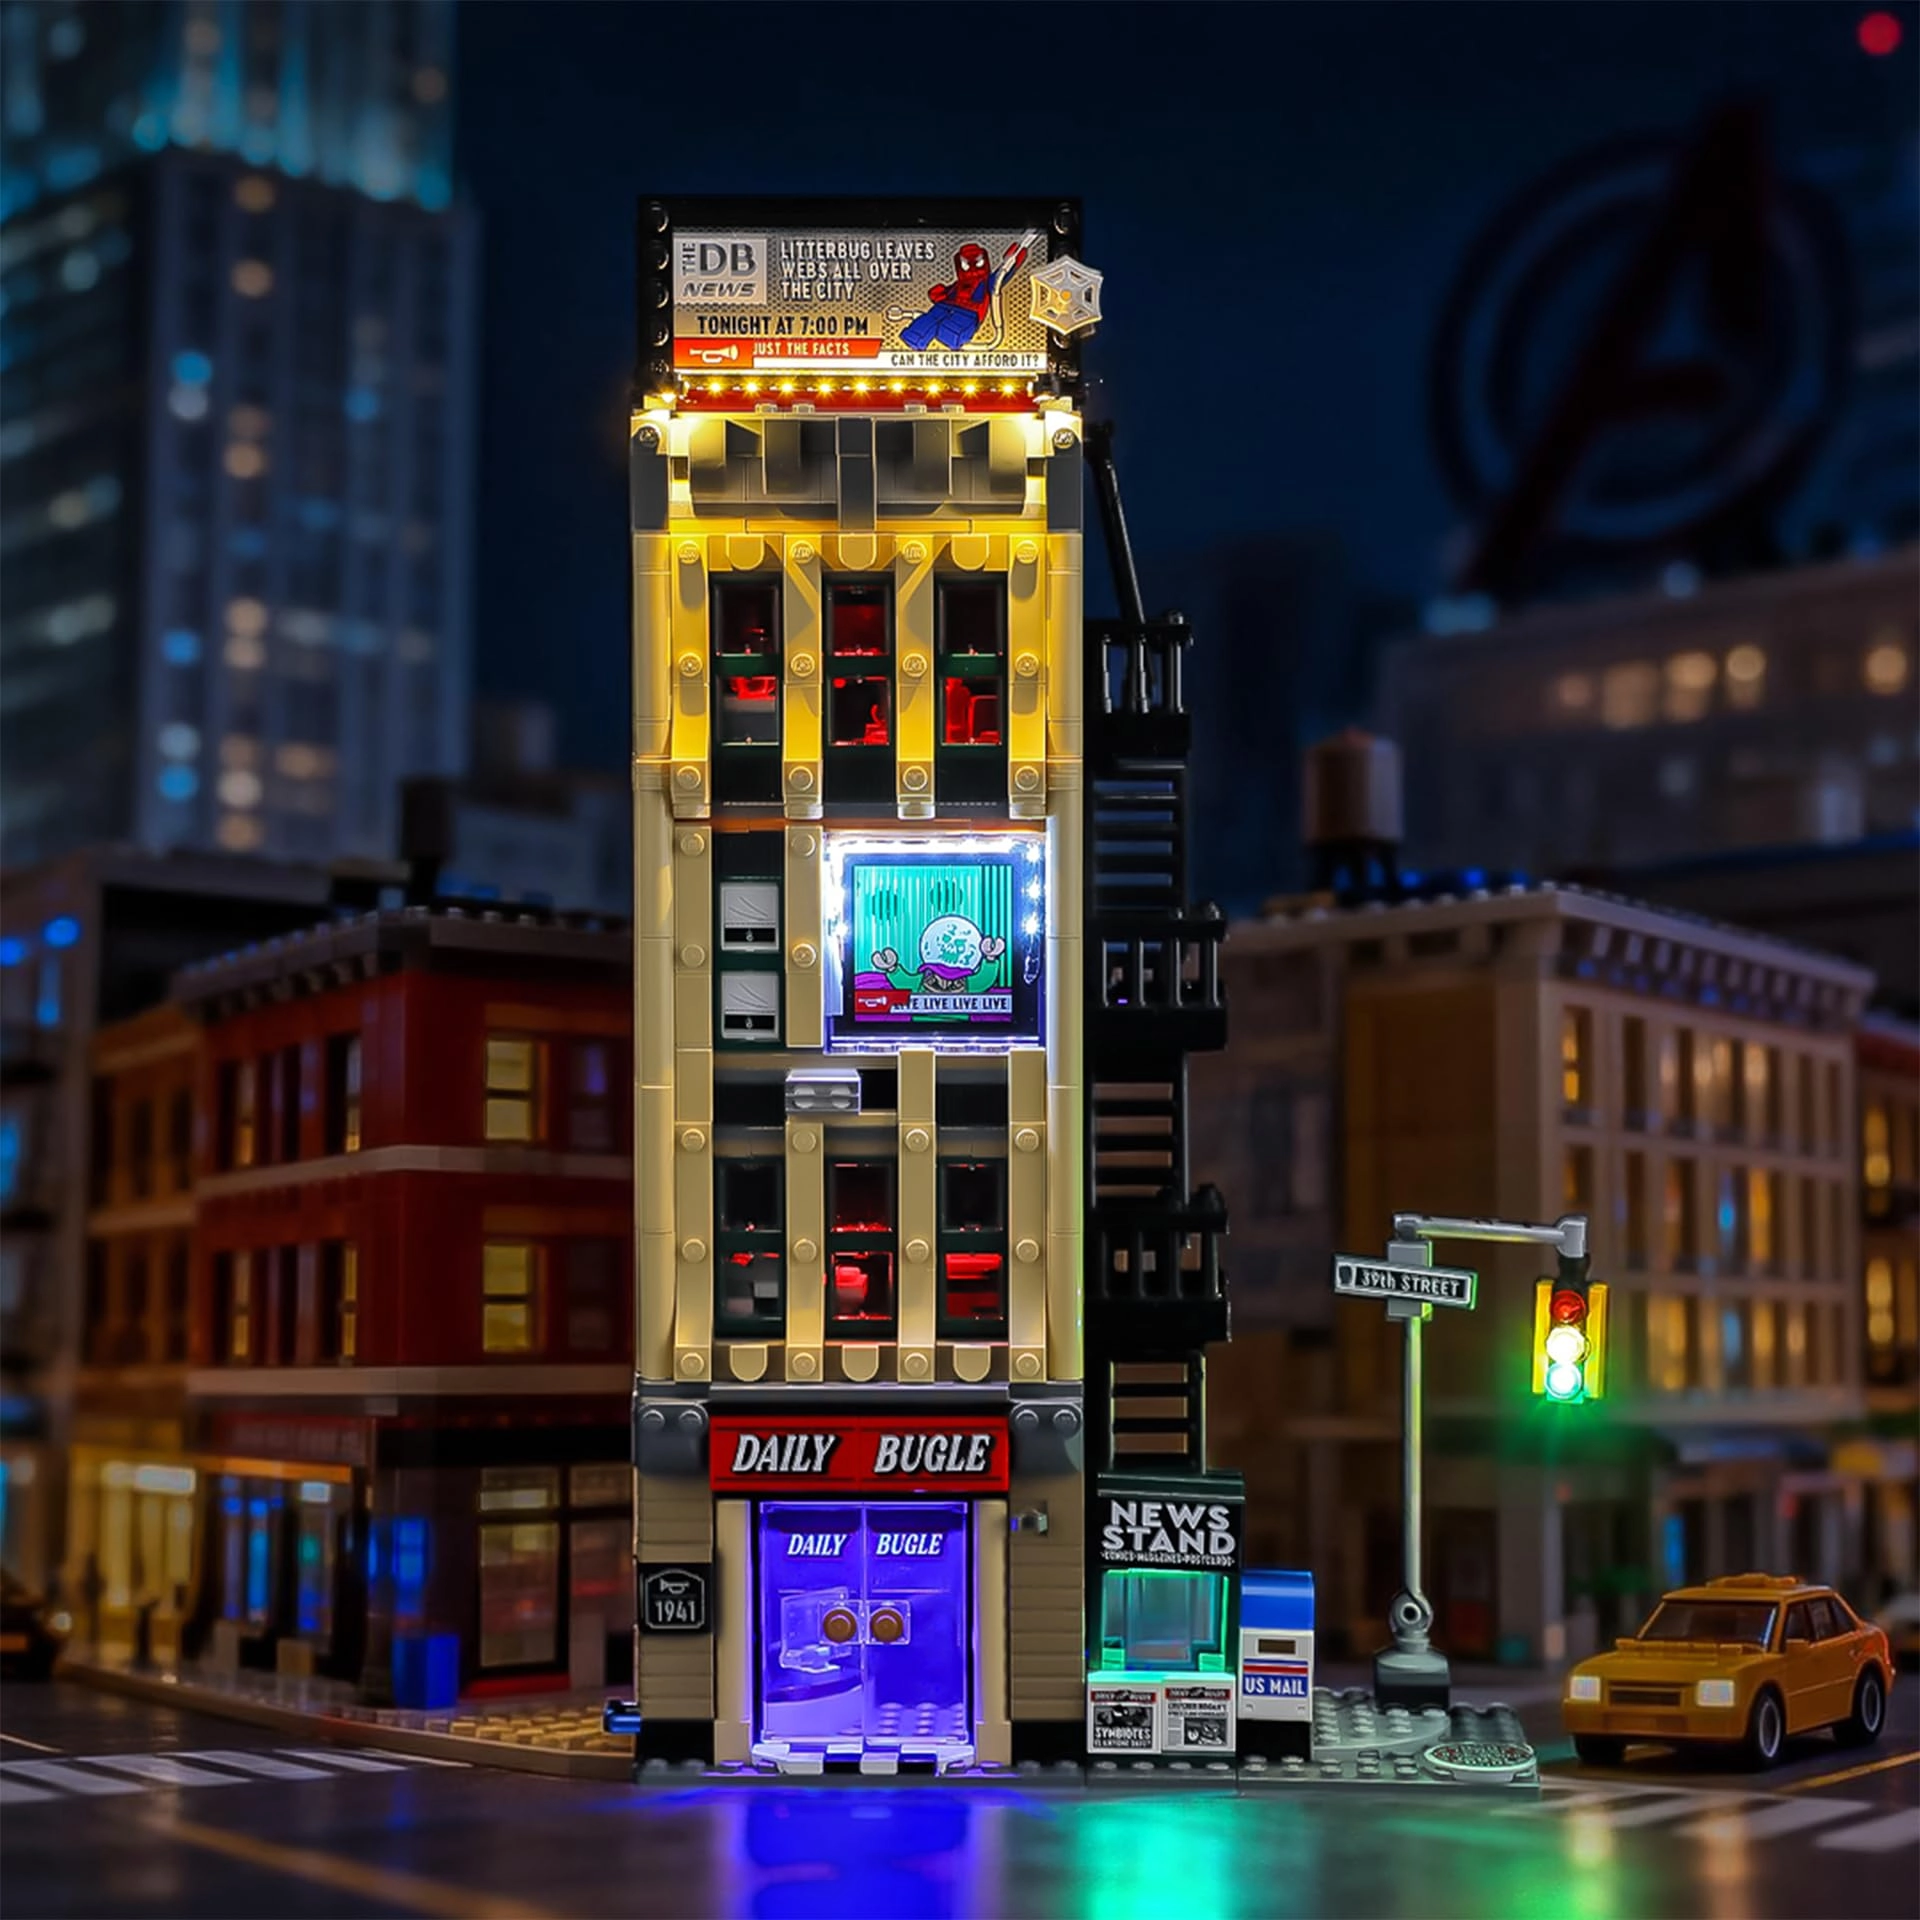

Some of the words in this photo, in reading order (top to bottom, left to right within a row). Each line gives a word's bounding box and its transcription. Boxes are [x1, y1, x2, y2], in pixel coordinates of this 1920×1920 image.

[682, 242, 696, 275] THE
[700, 243, 756, 277] DB
[780, 241, 871, 260] LITTERBUG
[876, 242, 935, 260] LEAVES
[781, 261, 828, 280] WEBS
[832, 261, 861, 280] ALL
[869, 262, 912, 281] OVER
[683, 282, 756, 298] NEWS
[781, 281, 812, 300] THE
[816, 281, 855, 300] CITY
[697, 315, 771, 335] TONIGHT
[775, 316, 795, 335] AT
[801, 316, 838, 335] 7:00
[843, 317, 869, 336] PM
[752, 342, 781, 356] JUST
[787, 342, 808, 356] THE
[812, 342, 850, 356] FACTS
[891, 354, 915, 367] CAN
[919, 354, 939, 367] THE
[943, 354, 969, 367] CITY
[974, 354, 1018, 368] AFFORD
[1021, 355, 1040, 368] IT?
[924, 997, 948, 1011] LIVE
[953, 997, 978, 1011] LIVE
[982, 997, 1007, 1011] LIVE
[1361, 1269, 1396, 1290] 39th
[1401, 1275, 1460, 1297] STREET
[731, 1433, 837, 1473] DAILY
[873, 1433, 991, 1474] BUGLE
[1110, 1500, 1230, 1531] NEWS
[786, 1533, 847, 1556] DAILY
[875, 1533, 943, 1556] BUGLE
[1102, 1526, 1236, 1555] STAND
[655, 1600, 696, 1622] 1941
[1245, 1677, 1265, 1694] US
[1270, 1679, 1305, 1696] MAIL
